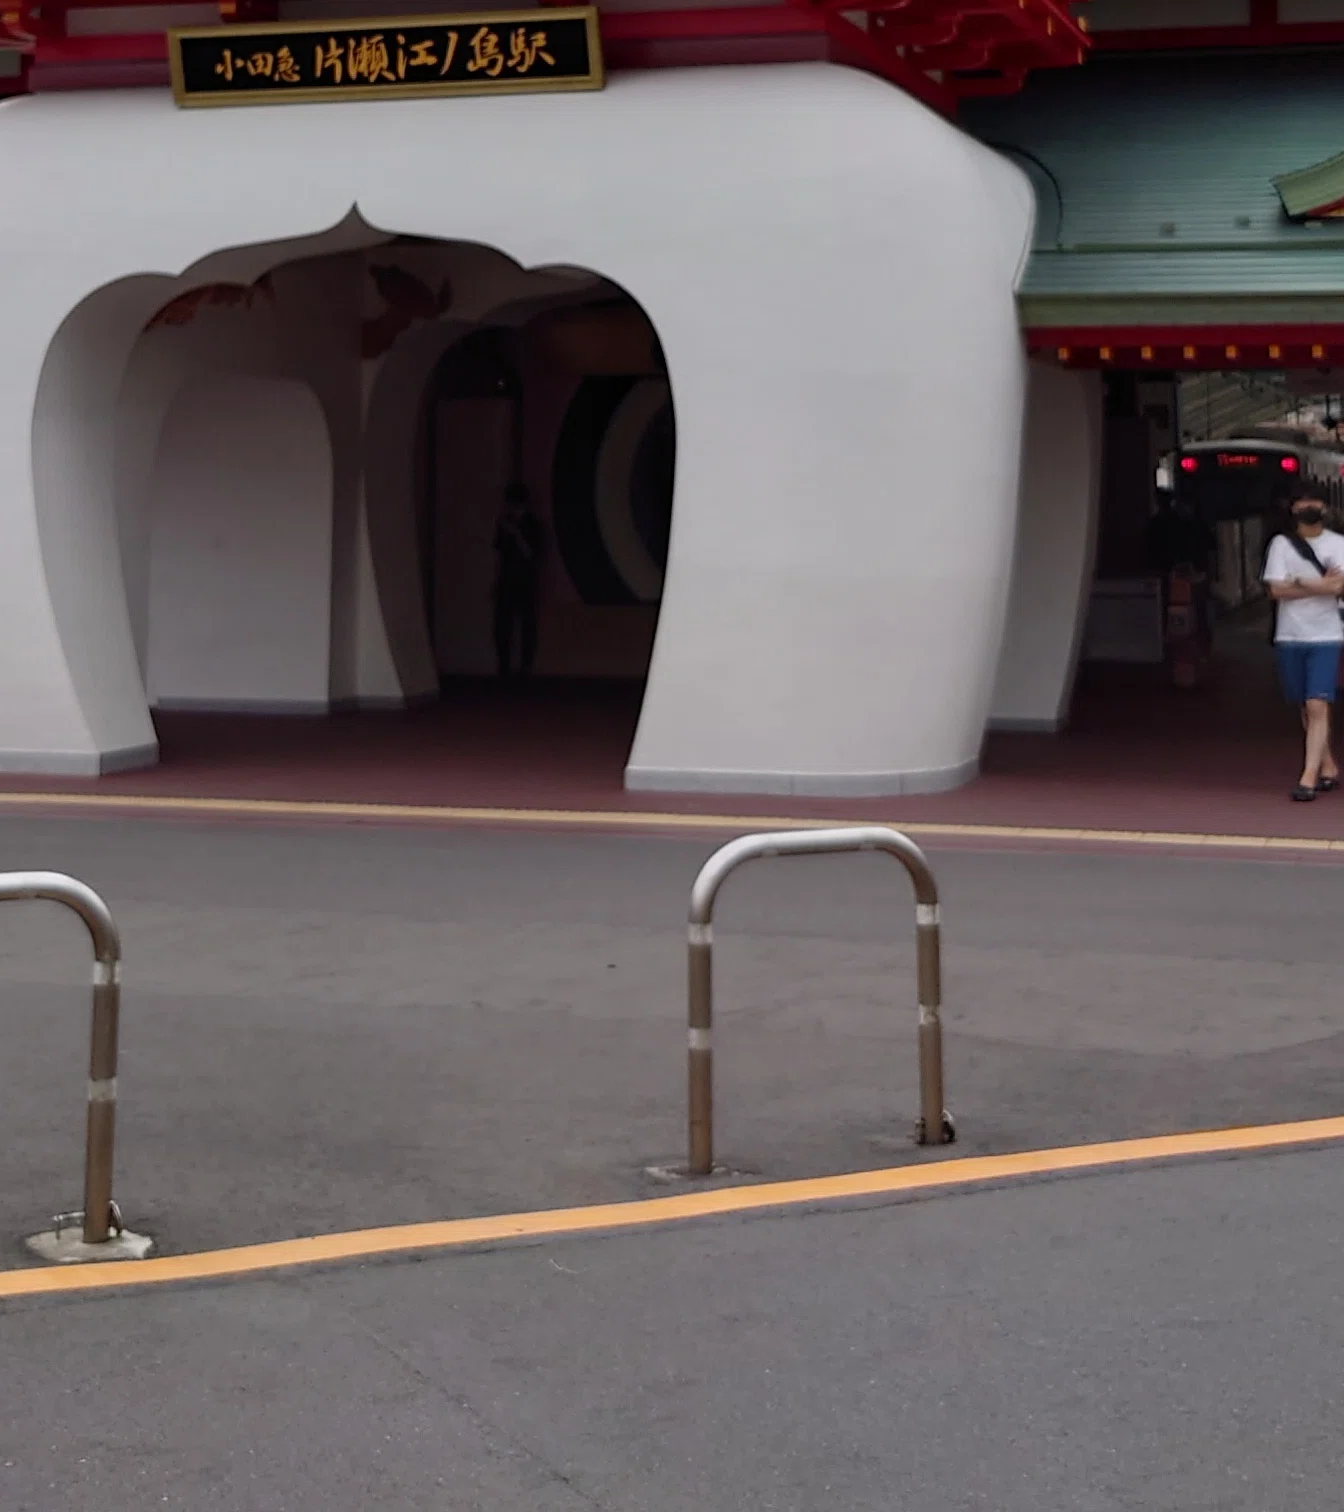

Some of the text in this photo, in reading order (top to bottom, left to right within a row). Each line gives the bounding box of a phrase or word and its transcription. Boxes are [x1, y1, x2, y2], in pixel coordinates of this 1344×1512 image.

[215, 27, 556, 84] 小田急 片瀬江ノ島駅
